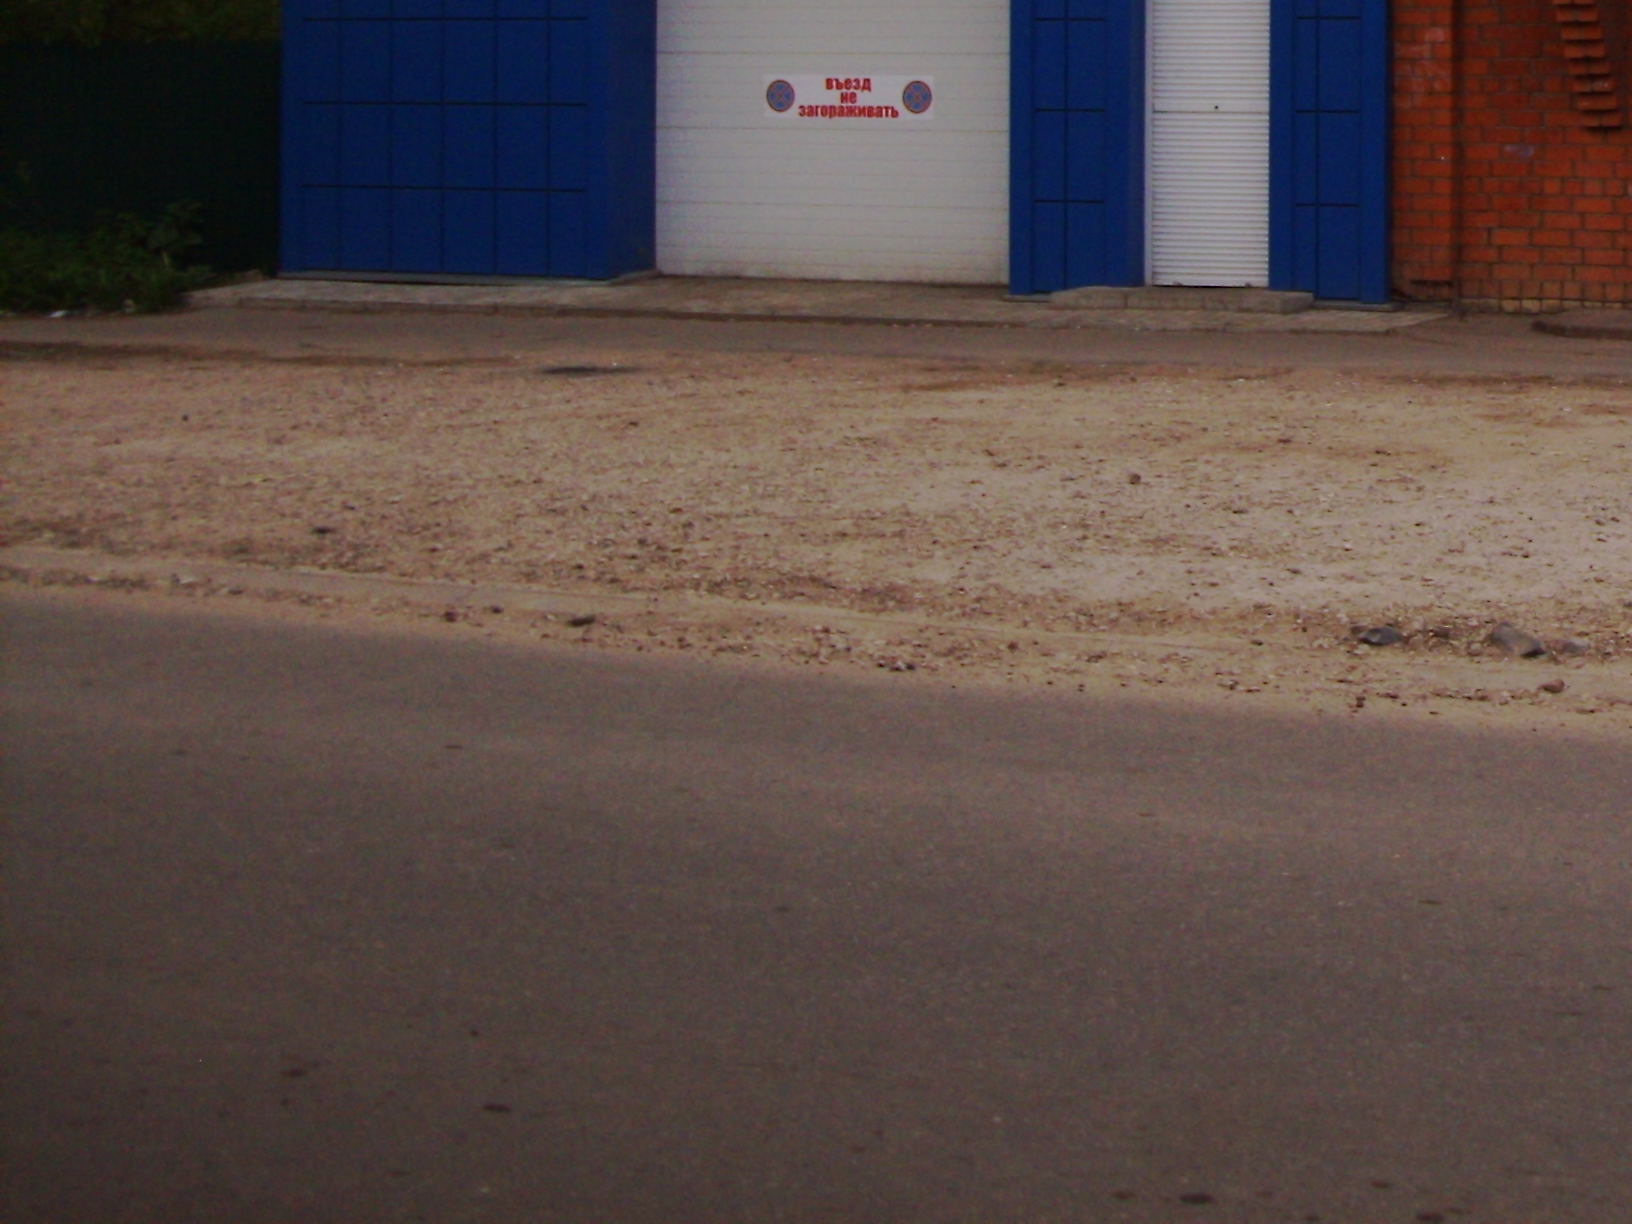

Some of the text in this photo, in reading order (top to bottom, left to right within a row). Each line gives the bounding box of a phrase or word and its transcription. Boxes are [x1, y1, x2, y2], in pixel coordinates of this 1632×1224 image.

[825, 78, 872, 92] въезд
[840, 92, 857, 104] не
[798, 105, 899, 119] загораживать
